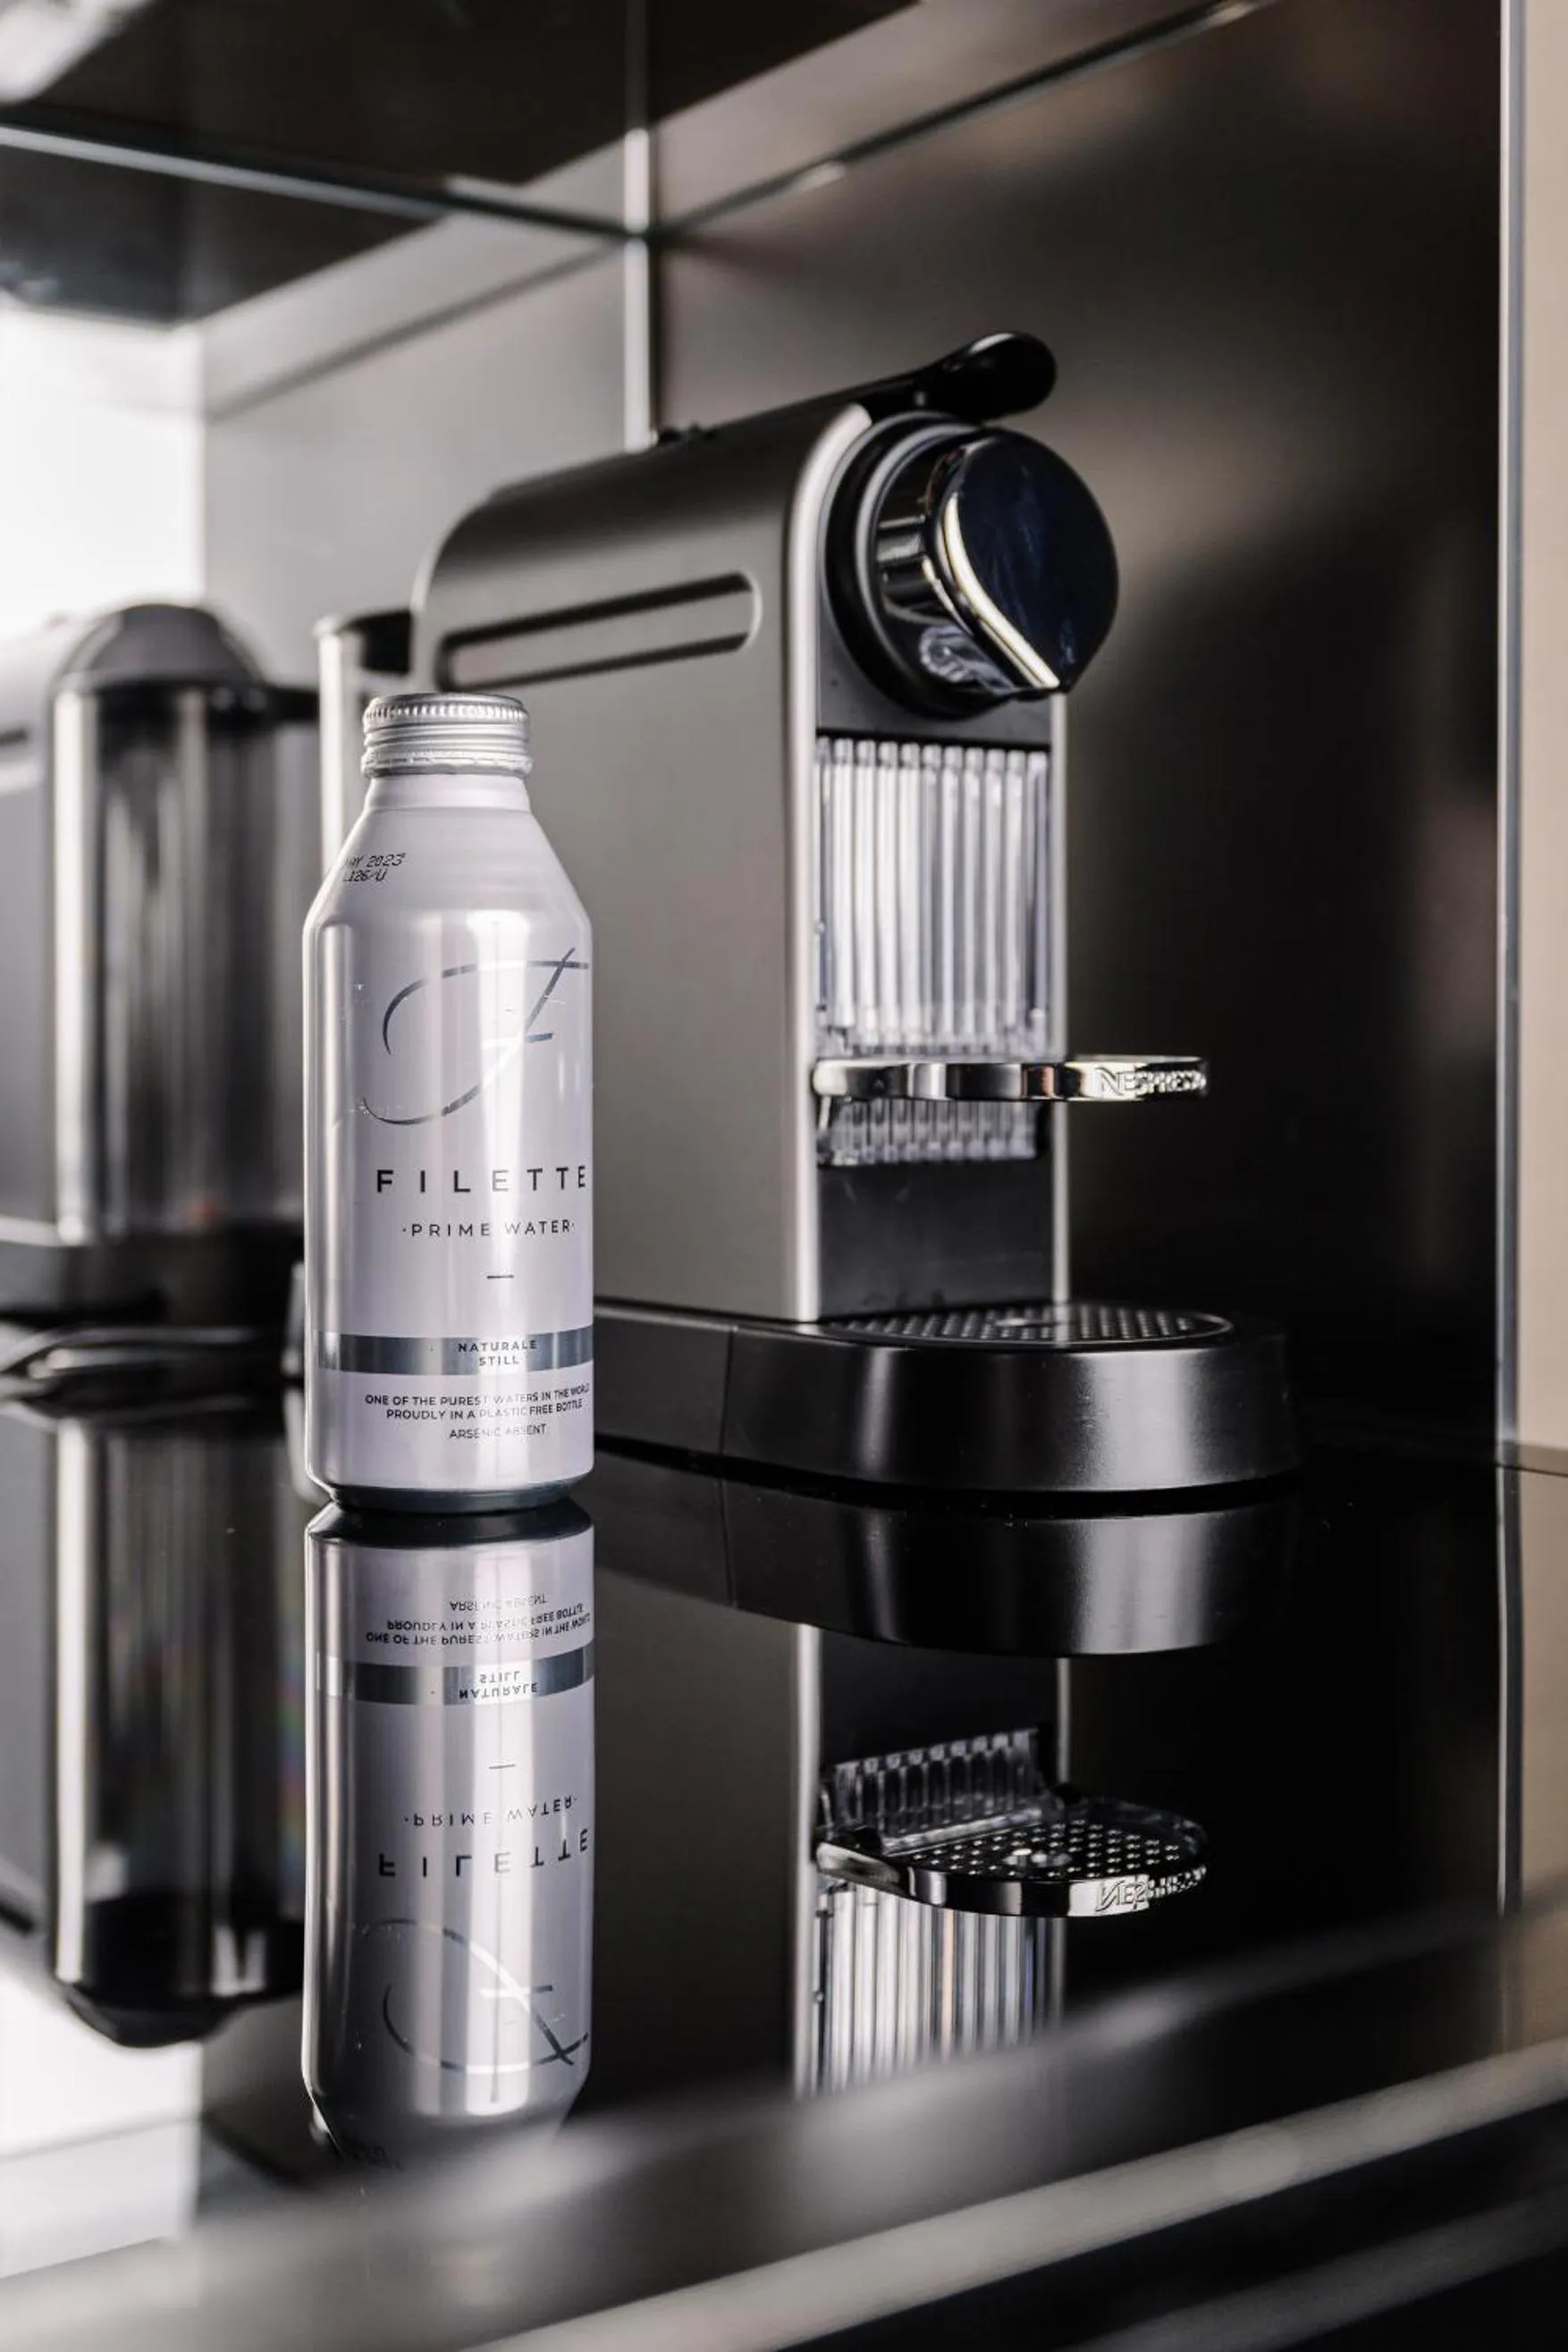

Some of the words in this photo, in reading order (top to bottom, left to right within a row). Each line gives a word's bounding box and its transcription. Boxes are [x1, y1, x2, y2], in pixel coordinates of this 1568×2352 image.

[366, 852, 406, 868] 2023
[376, 1165, 586, 1193] FILETTE
[457, 1339, 537, 1353] NATURALE
[478, 1355, 522, 1367] STILL
[365, 1394, 389, 1406] ONE
[392, 1395, 409, 1406] OF
[413, 1395, 436, 1407] THE
[440, 1394, 489, 1407] PUREST
[493, 1392, 539, 1404] WATERS
[542, 1390, 552, 1402] IN
[554, 1387, 569, 1401] THE
[386, 1408, 445, 1420] PROUDLY
[450, 1409, 464, 1420] IN
[467, 1409, 476, 1420] A
[479, 1406, 527, 1419] PLASTIC
[529, 1404, 554, 1416] FREE
[556, 1398, 584, 1412] BOTTLE
[449, 1427, 502, 1439] ARSENIC
